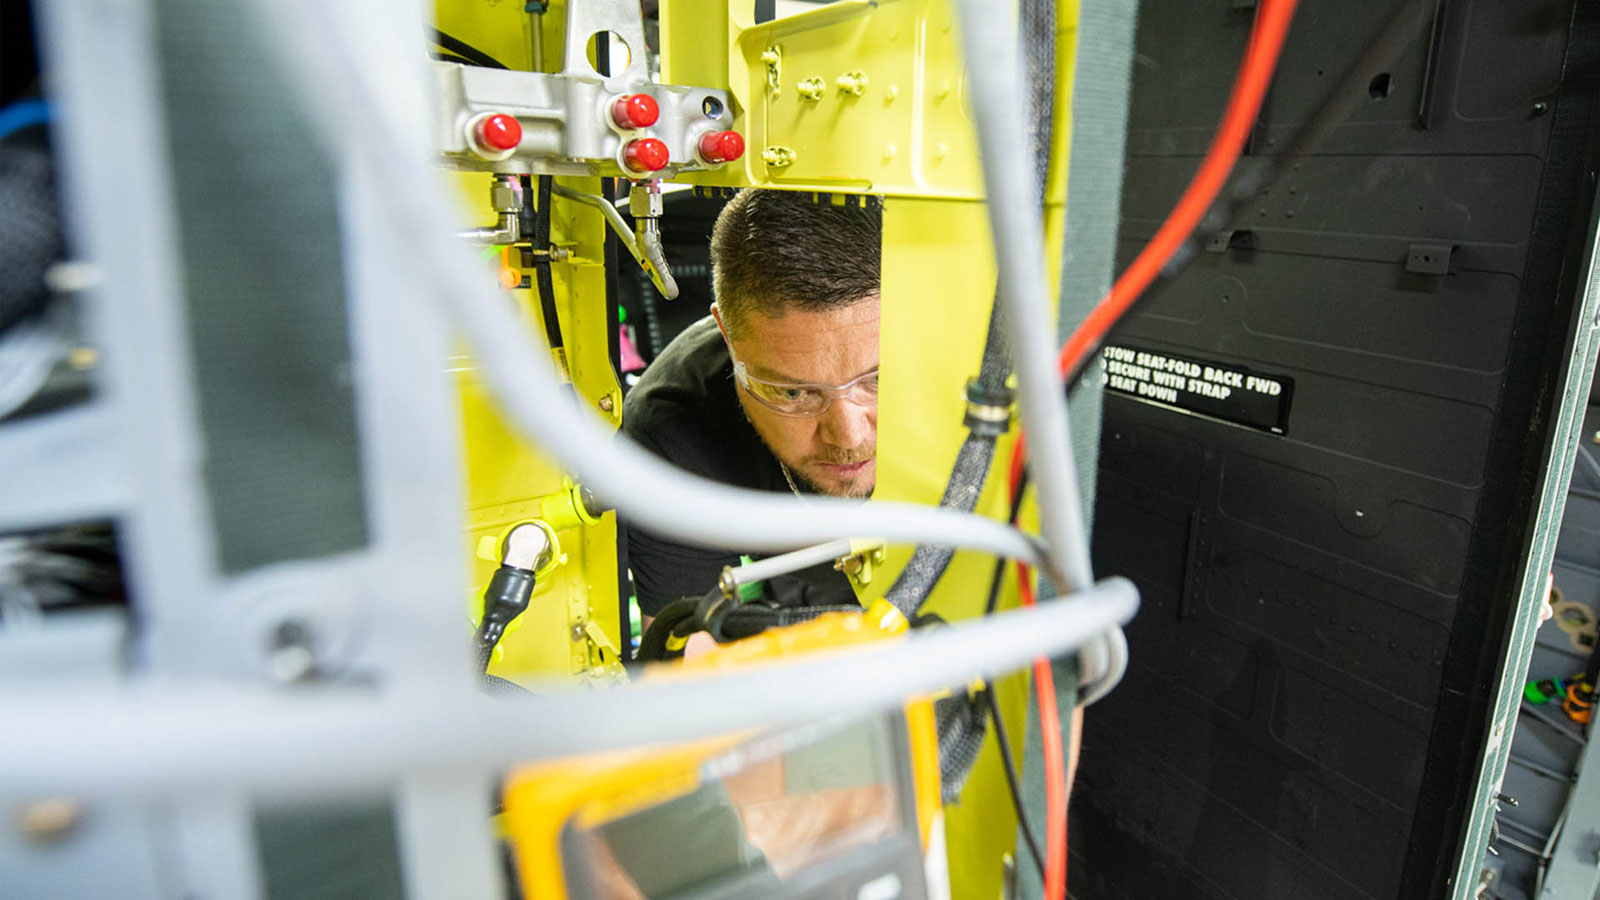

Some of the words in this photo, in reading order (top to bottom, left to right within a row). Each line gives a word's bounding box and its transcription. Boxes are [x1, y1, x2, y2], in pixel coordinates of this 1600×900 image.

[1104, 346, 1135, 362] STOW
[1137, 352, 1201, 377] SEAT-FOLD
[1204, 367, 1243, 388] BACK
[1246, 376, 1281, 396] FWD
[1109, 360, 1150, 381] SECURE
[1152, 371, 1185, 390] WITH
[1188, 379, 1231, 400] STRAP
[1110, 374, 1137, 392] SEAT
[1138, 382, 1178, 403] DOWN
